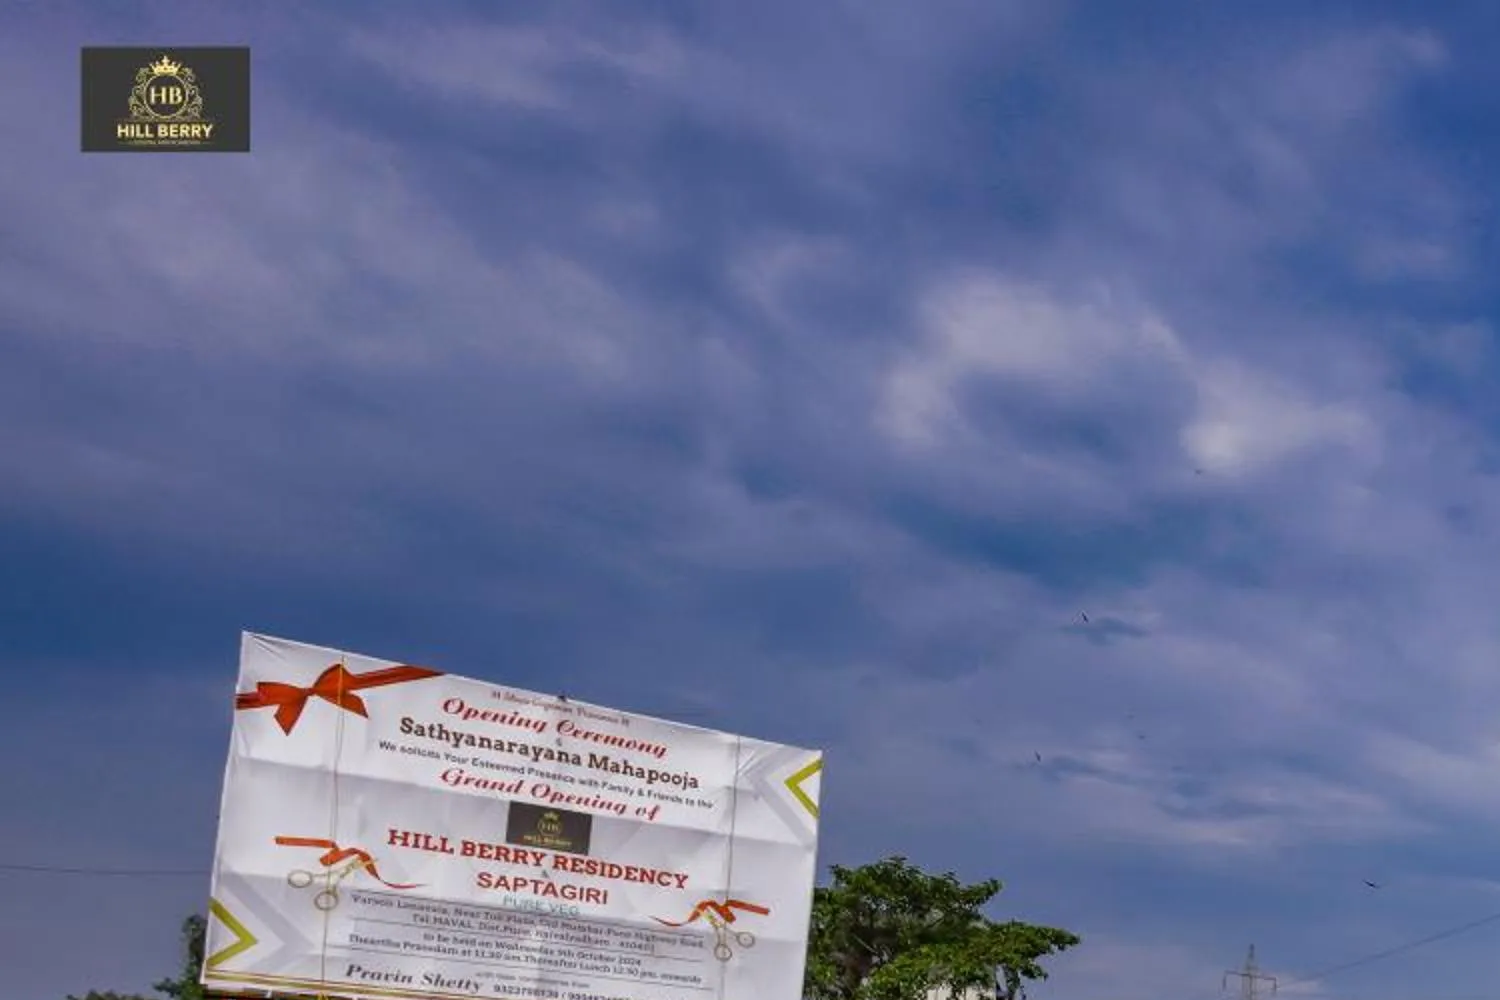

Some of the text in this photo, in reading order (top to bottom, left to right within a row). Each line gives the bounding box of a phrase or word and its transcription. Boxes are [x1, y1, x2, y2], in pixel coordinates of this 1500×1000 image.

[398, 716, 582, 769] Sathyanarayana
[587, 752, 699, 791] Mahapooja
[442, 695, 548, 734] Opening
[555, 717, 667, 758] Ceremony
[440, 766, 660, 821] Grand Opening of
[386, 829, 689, 889] HILL BERRY RESIDENCY
[475, 871, 608, 905] SAPTAGIRI
[345, 964, 413, 983] Pravin
[419, 971, 481, 993] Shetty
